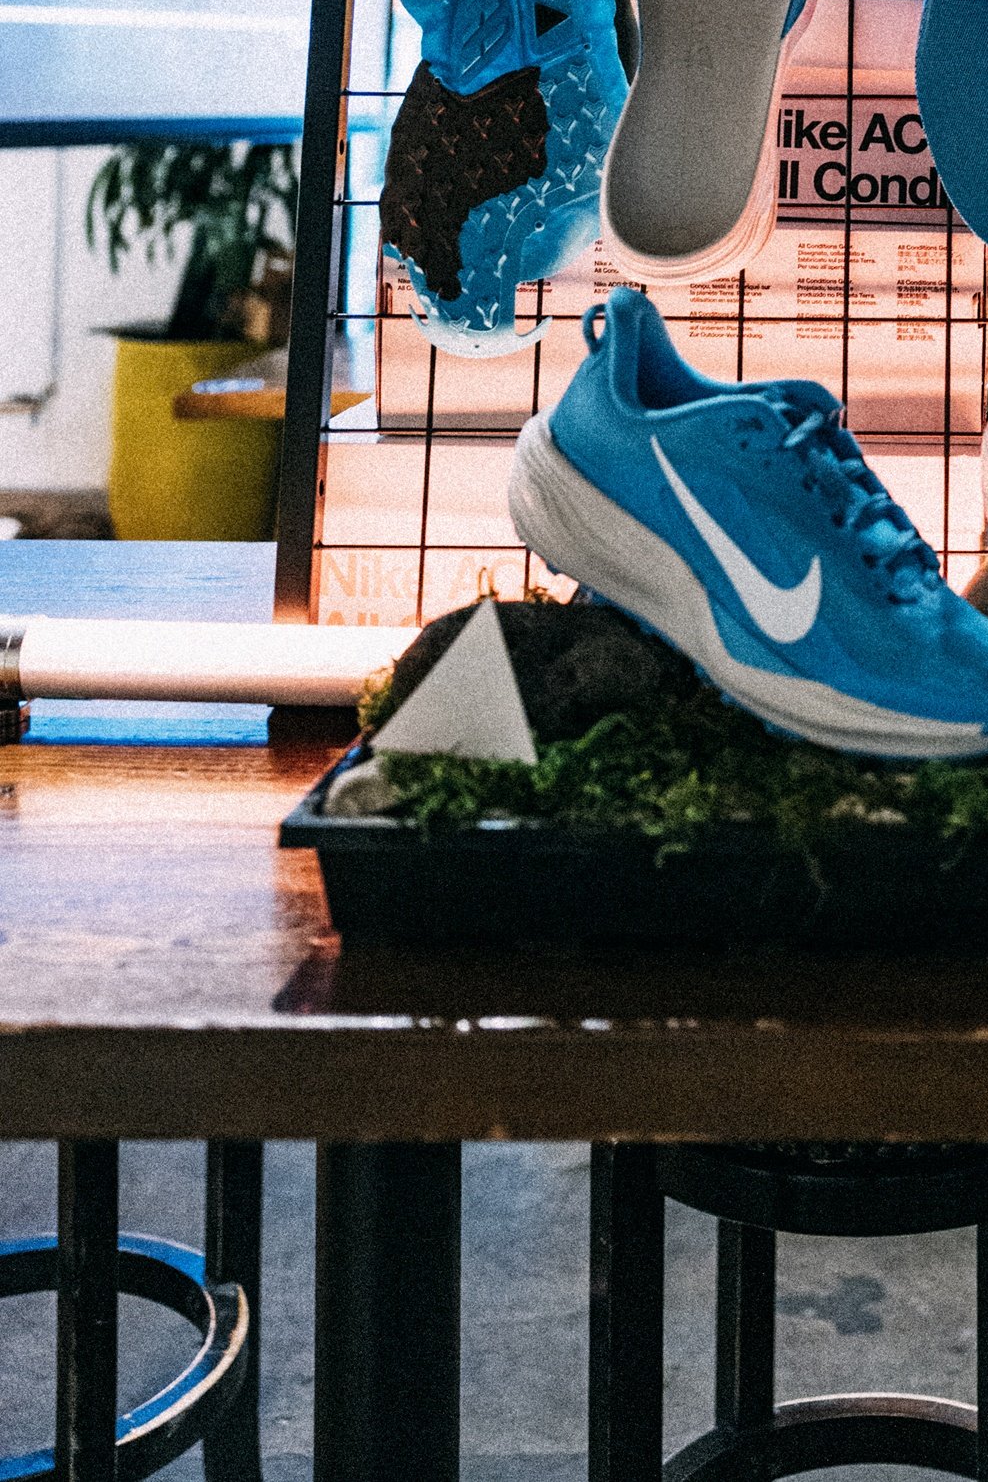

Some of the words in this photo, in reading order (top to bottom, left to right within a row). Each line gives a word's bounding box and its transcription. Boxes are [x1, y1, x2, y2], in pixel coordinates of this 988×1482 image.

[777, 109, 848, 152] ike
[858, 112, 928, 155] AC
[778, 160, 800, 200] ll
